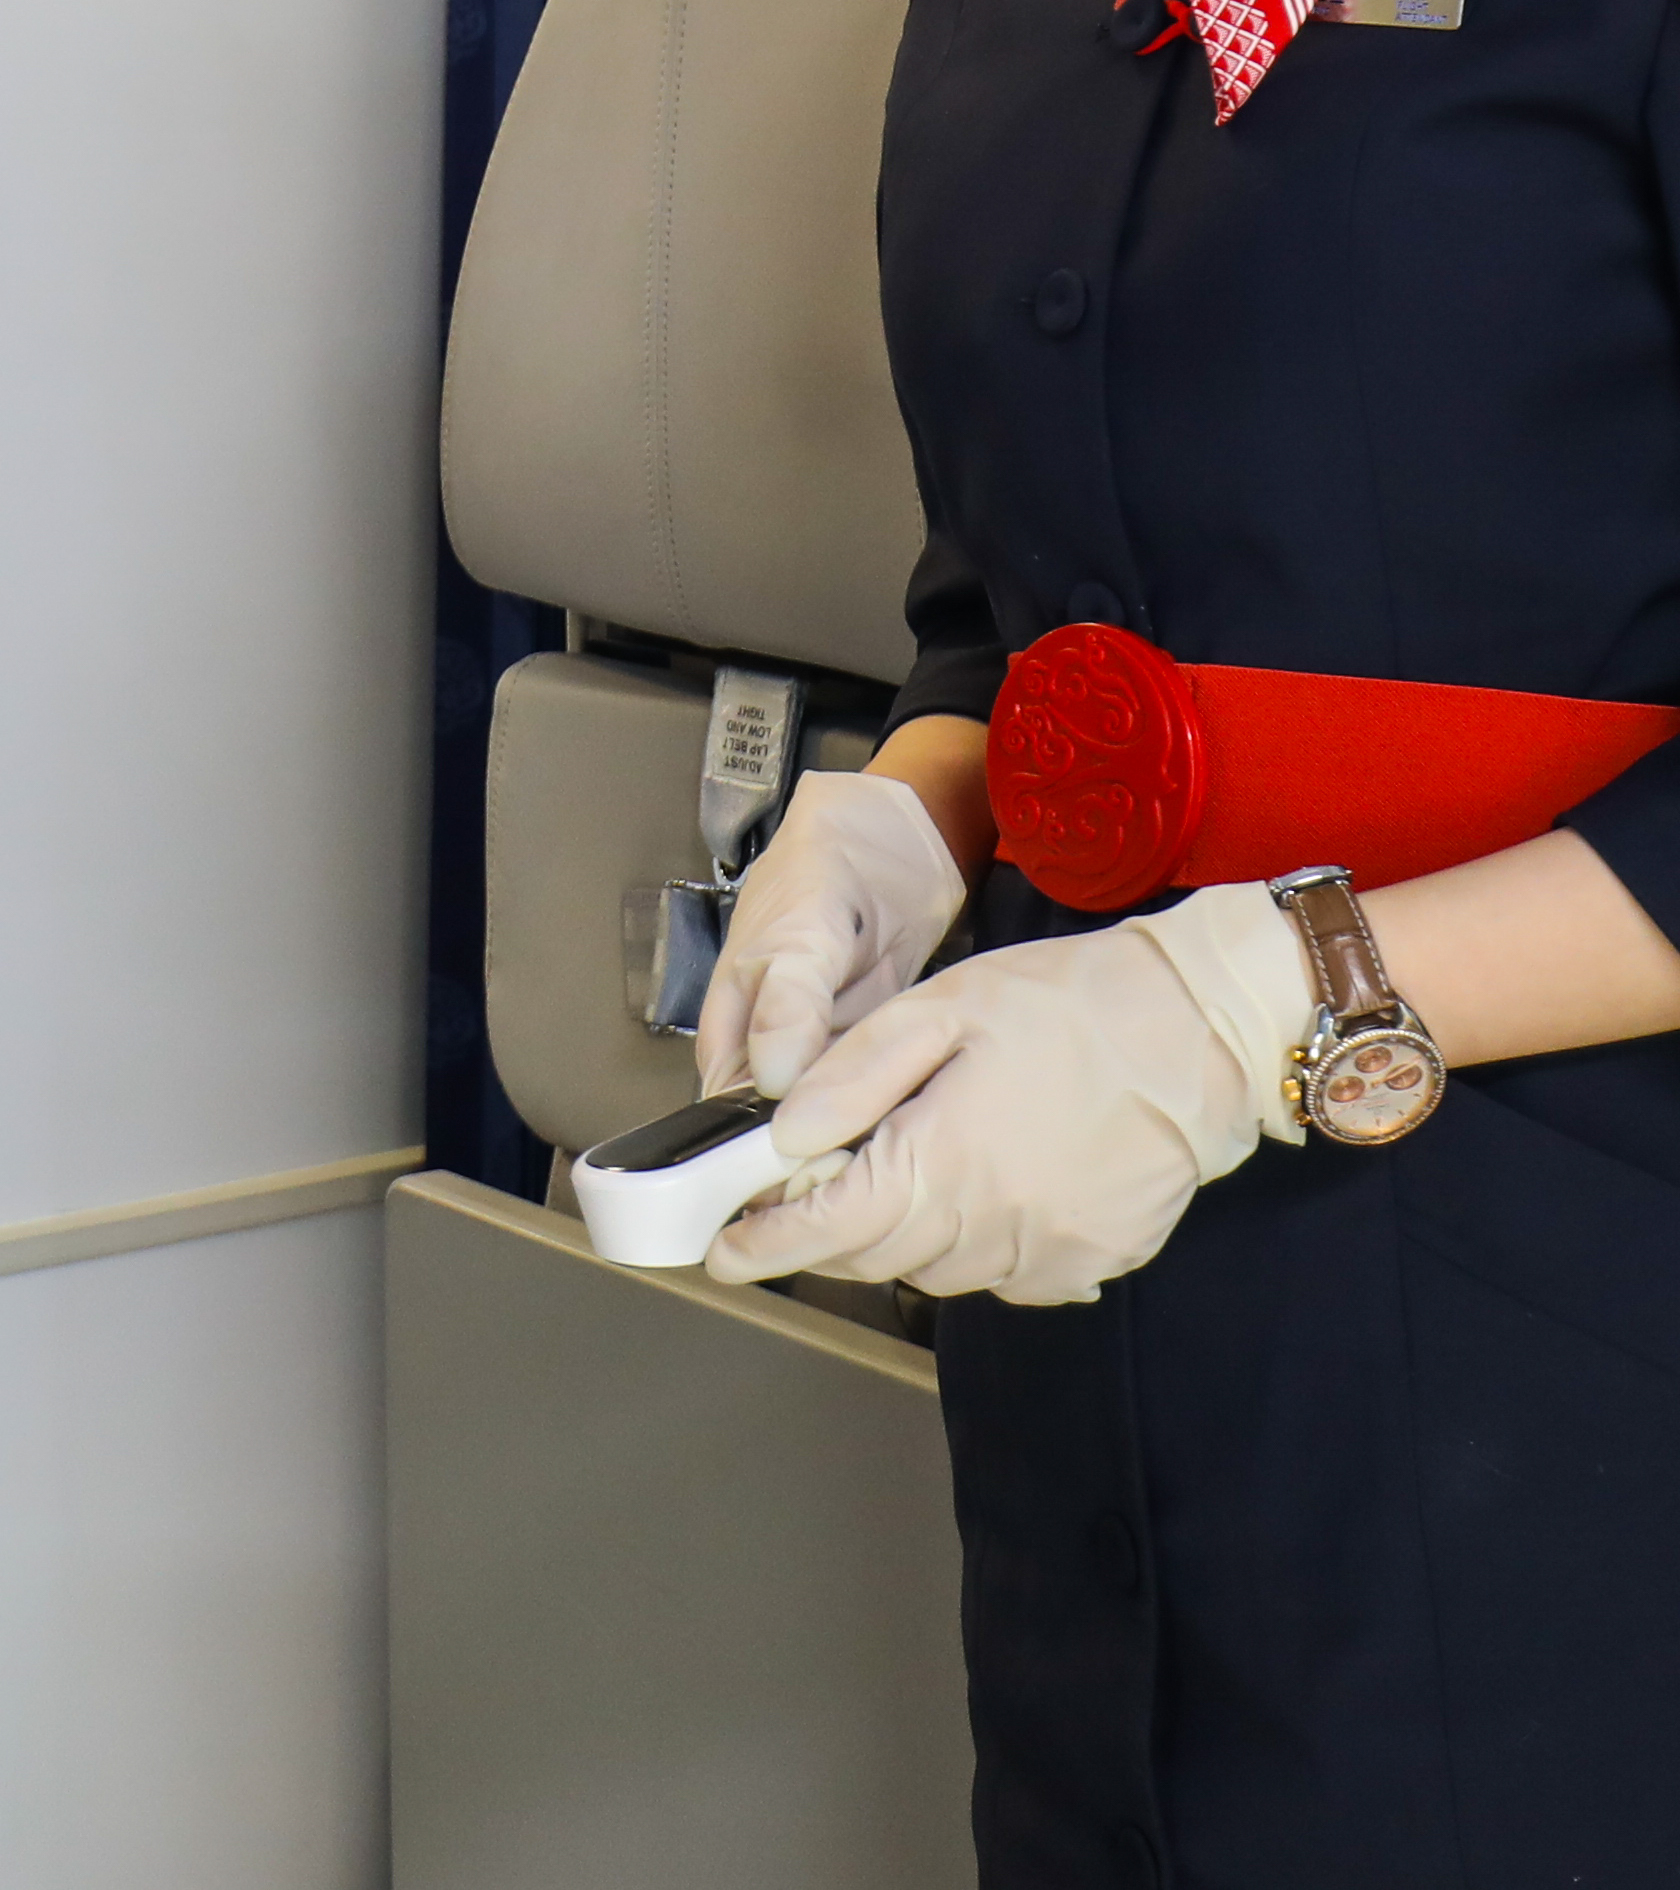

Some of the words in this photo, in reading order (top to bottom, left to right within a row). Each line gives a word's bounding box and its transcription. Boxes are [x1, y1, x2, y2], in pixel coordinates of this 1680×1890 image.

[736, 704, 766, 721] TIGHT
[726, 719, 747, 734] AND
[747, 723, 773, 739] LOW
[722, 736, 748, 754] BELT
[749, 743, 769, 756] LAP
[723, 755, 763, 774] ADJUST
